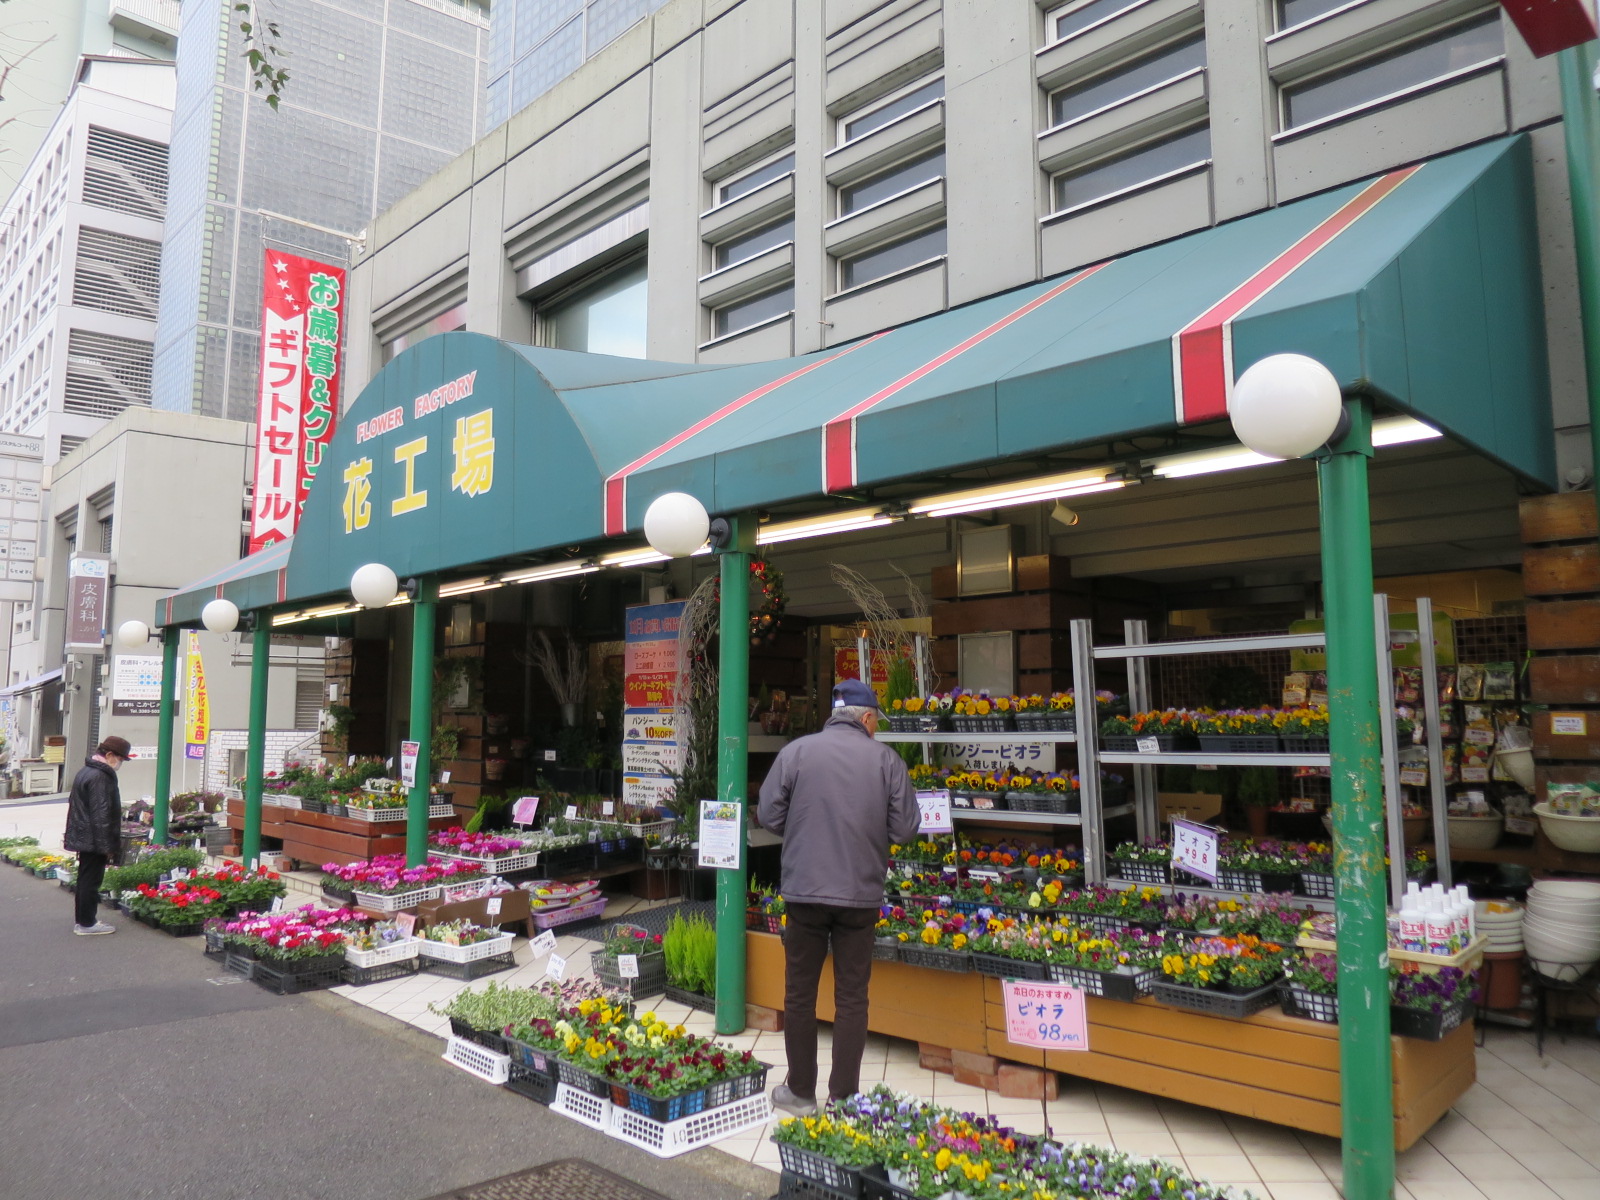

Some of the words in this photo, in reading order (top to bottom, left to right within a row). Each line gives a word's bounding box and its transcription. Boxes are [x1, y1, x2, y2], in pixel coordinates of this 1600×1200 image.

[299, 272, 341, 512] お歳暮&クリ
[356, 405, 404, 445] FLOWER
[414, 369, 478, 420] FACTORY
[259, 328, 299, 521] ギフトセール
[343, 407, 495, 534] 花工場
[79, 582, 98, 622] 皮膚科
[943, 743, 1042, 760] パンジー・ビオラ
[1180, 831, 1211, 852] ビオラ
[1013, 986, 1073, 1000] 本日のおすすめ
[1018, 1001, 1064, 1020] ビオラ
